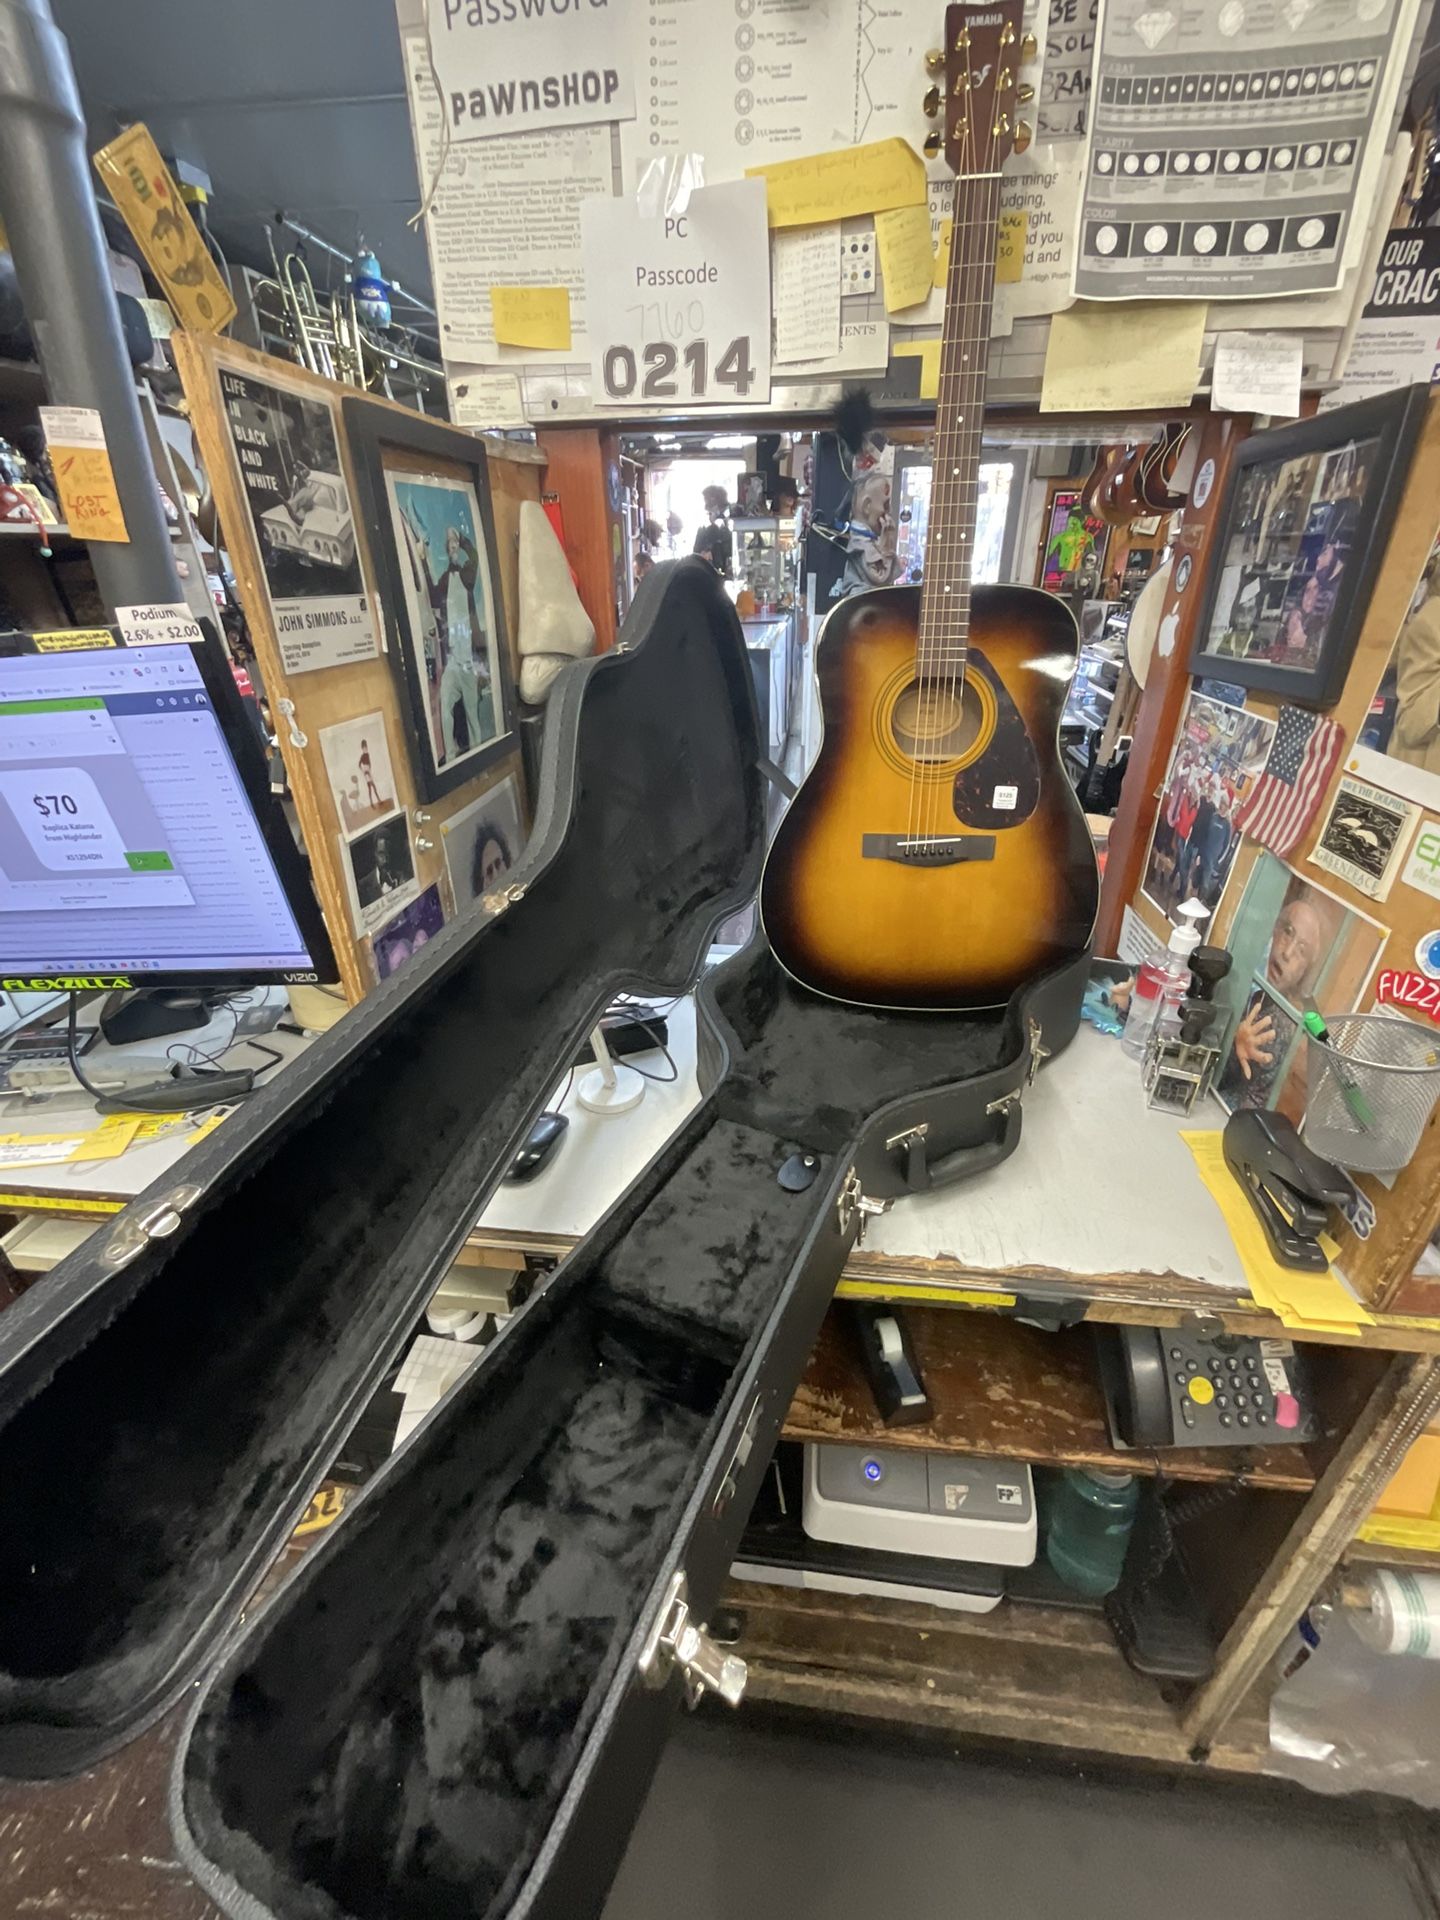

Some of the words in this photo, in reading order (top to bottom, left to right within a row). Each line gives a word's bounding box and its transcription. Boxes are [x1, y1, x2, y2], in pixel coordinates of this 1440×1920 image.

[444, 0, 608, 30] Passwo
[965, 13, 1003, 28] YAMAHA
[1001, 194, 1046, 210] udging,
[1028, 212, 1054, 226] ight.
[1084, 207, 1118, 220] COLOR
[664, 216, 689, 240] PC
[1040, 232, 1064, 249] you
[1036, 248, 1061, 263] and
[1383, 239, 1424, 268] OUR
[636, 262, 719, 287] Passcode
[602, 335, 757, 400] 0214
[223, 375, 247, 398] LIFE
[228, 399, 242, 419] IN
[233, 423, 270, 449] BLACK
[241, 448, 263, 467] AND
[245, 471, 279, 492] WHITE
[66, 493, 108, 508] LOST
[131, 606, 178, 622] Podium
[278, 613, 305, 633] JOHN
[305, 610, 348, 629] SIMMONS
[124, 625, 155, 643] 2.6%
[166, 623, 201, 639] $2.00
[33, 794, 79, 818] $70
[1315, 848, 1380, 892] GREENPEACE
[2, 976, 134, 991] FLEXZILLA
[283, 972, 319, 983] VIZIO
[1379, 972, 1440, 1015] FUZZ
